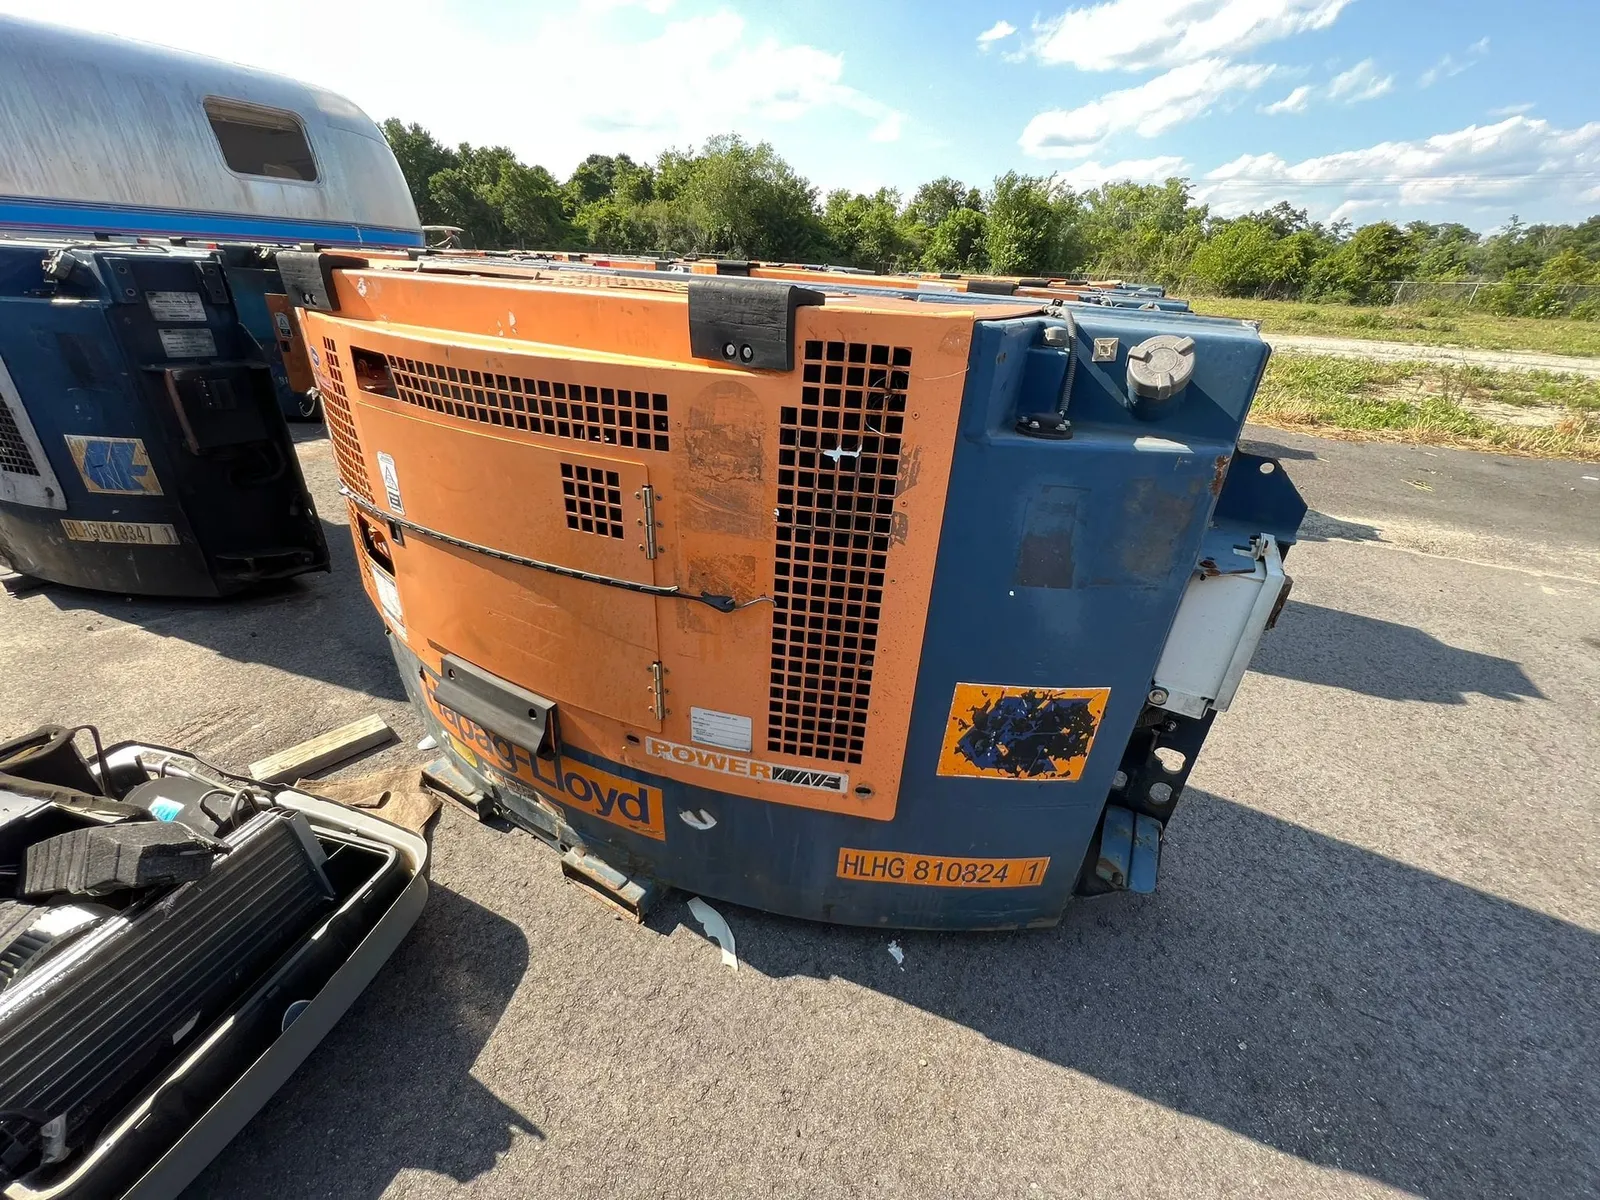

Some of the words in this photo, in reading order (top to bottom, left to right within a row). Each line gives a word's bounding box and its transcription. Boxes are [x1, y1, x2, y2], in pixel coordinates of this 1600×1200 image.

[843, 854, 905, 878] HLHG
[913, 860, 1008, 883] 810824
[1027, 861, 1039, 882] 1
